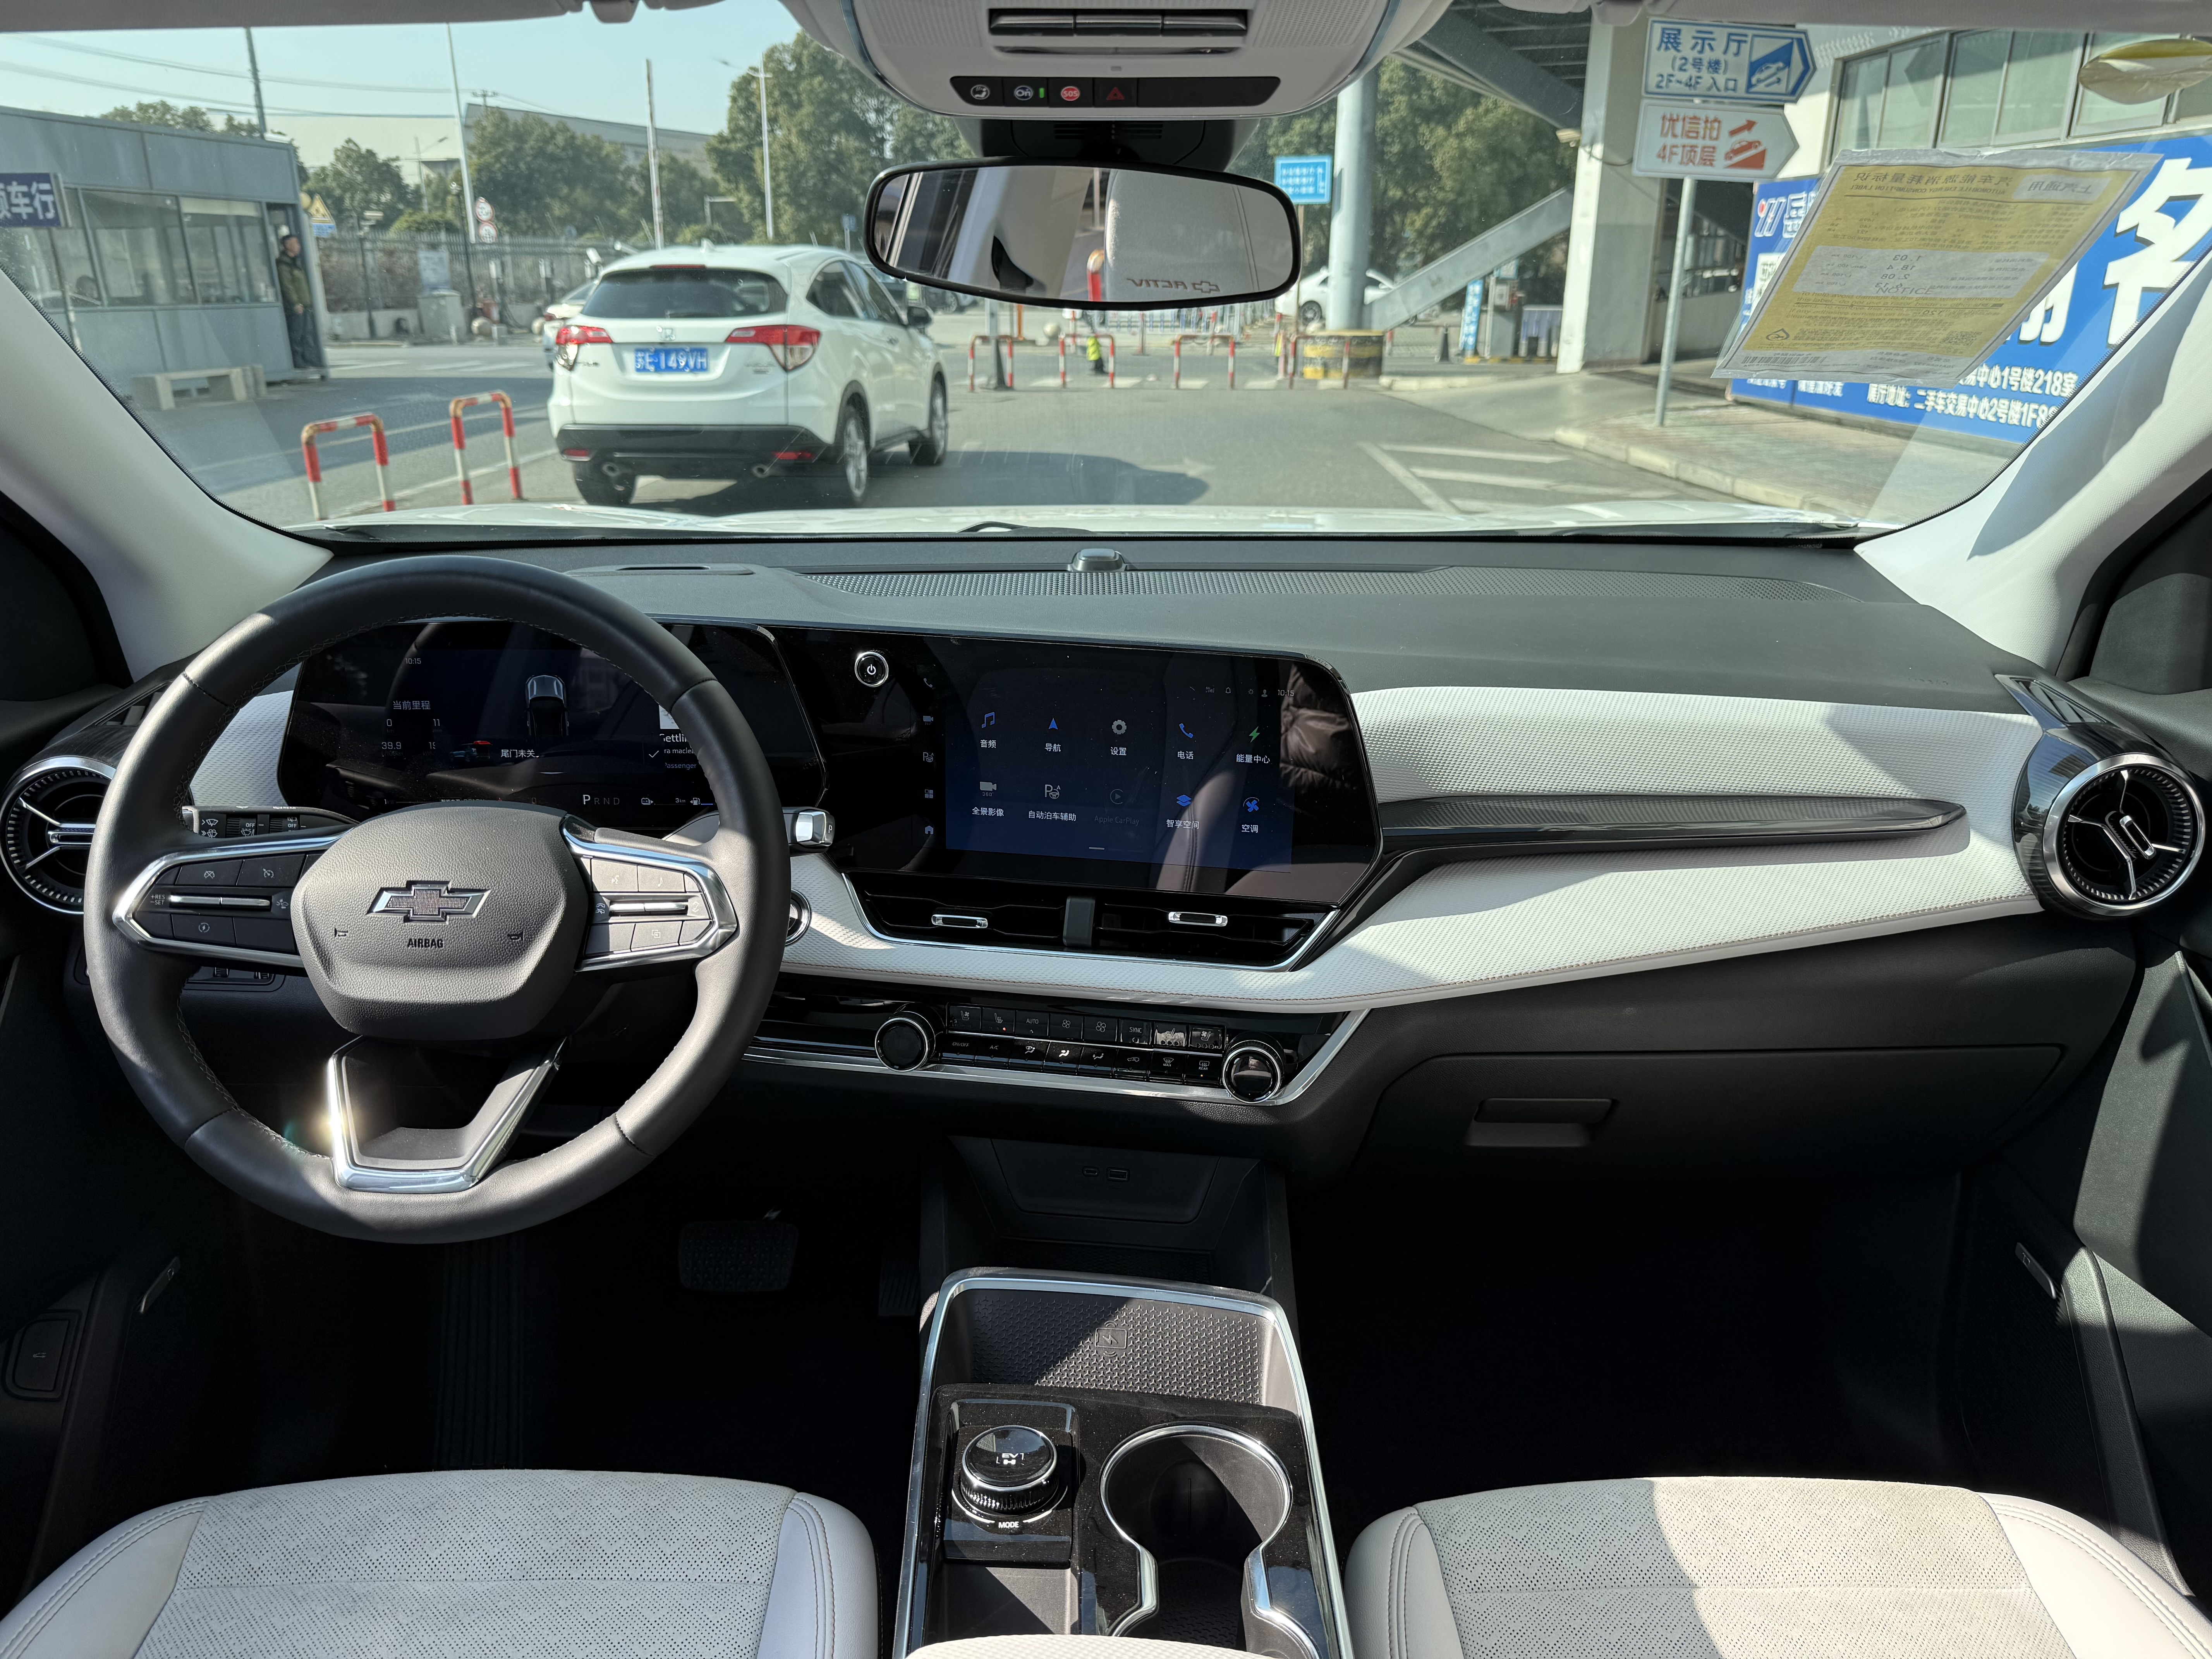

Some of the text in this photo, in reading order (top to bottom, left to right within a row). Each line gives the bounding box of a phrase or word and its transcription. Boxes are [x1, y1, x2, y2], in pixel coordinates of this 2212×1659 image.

[1657, 27, 1748, 57] 展示厅
[1655, 74, 1737, 93] 2F~4F 入口
[1660, 112, 1721, 141] 优信拍
[1656, 144, 1717, 167] 4F顶层
[393, 700, 431, 710] 当前里程
[381, 742, 402, 750] 39.9
[980, 739, 996, 748] 音频
[1044, 743, 1061, 752] 导航
[1110, 747, 1127, 756] 设置
[1177, 751, 1194, 760] 电话
[1236, 754, 1270, 764] 能量中心
[583, 794, 591, 805] P
[972, 807, 1004, 817] 全景影像
[1028, 810, 1077, 822] 自动泊车辅助
[1094, 815, 1139, 826] Apple CarPlay
[1166, 819, 1199, 829] 智享空间
[1241, 824, 1259, 833] 空调
[407, 938, 444, 949] AIRBAG
